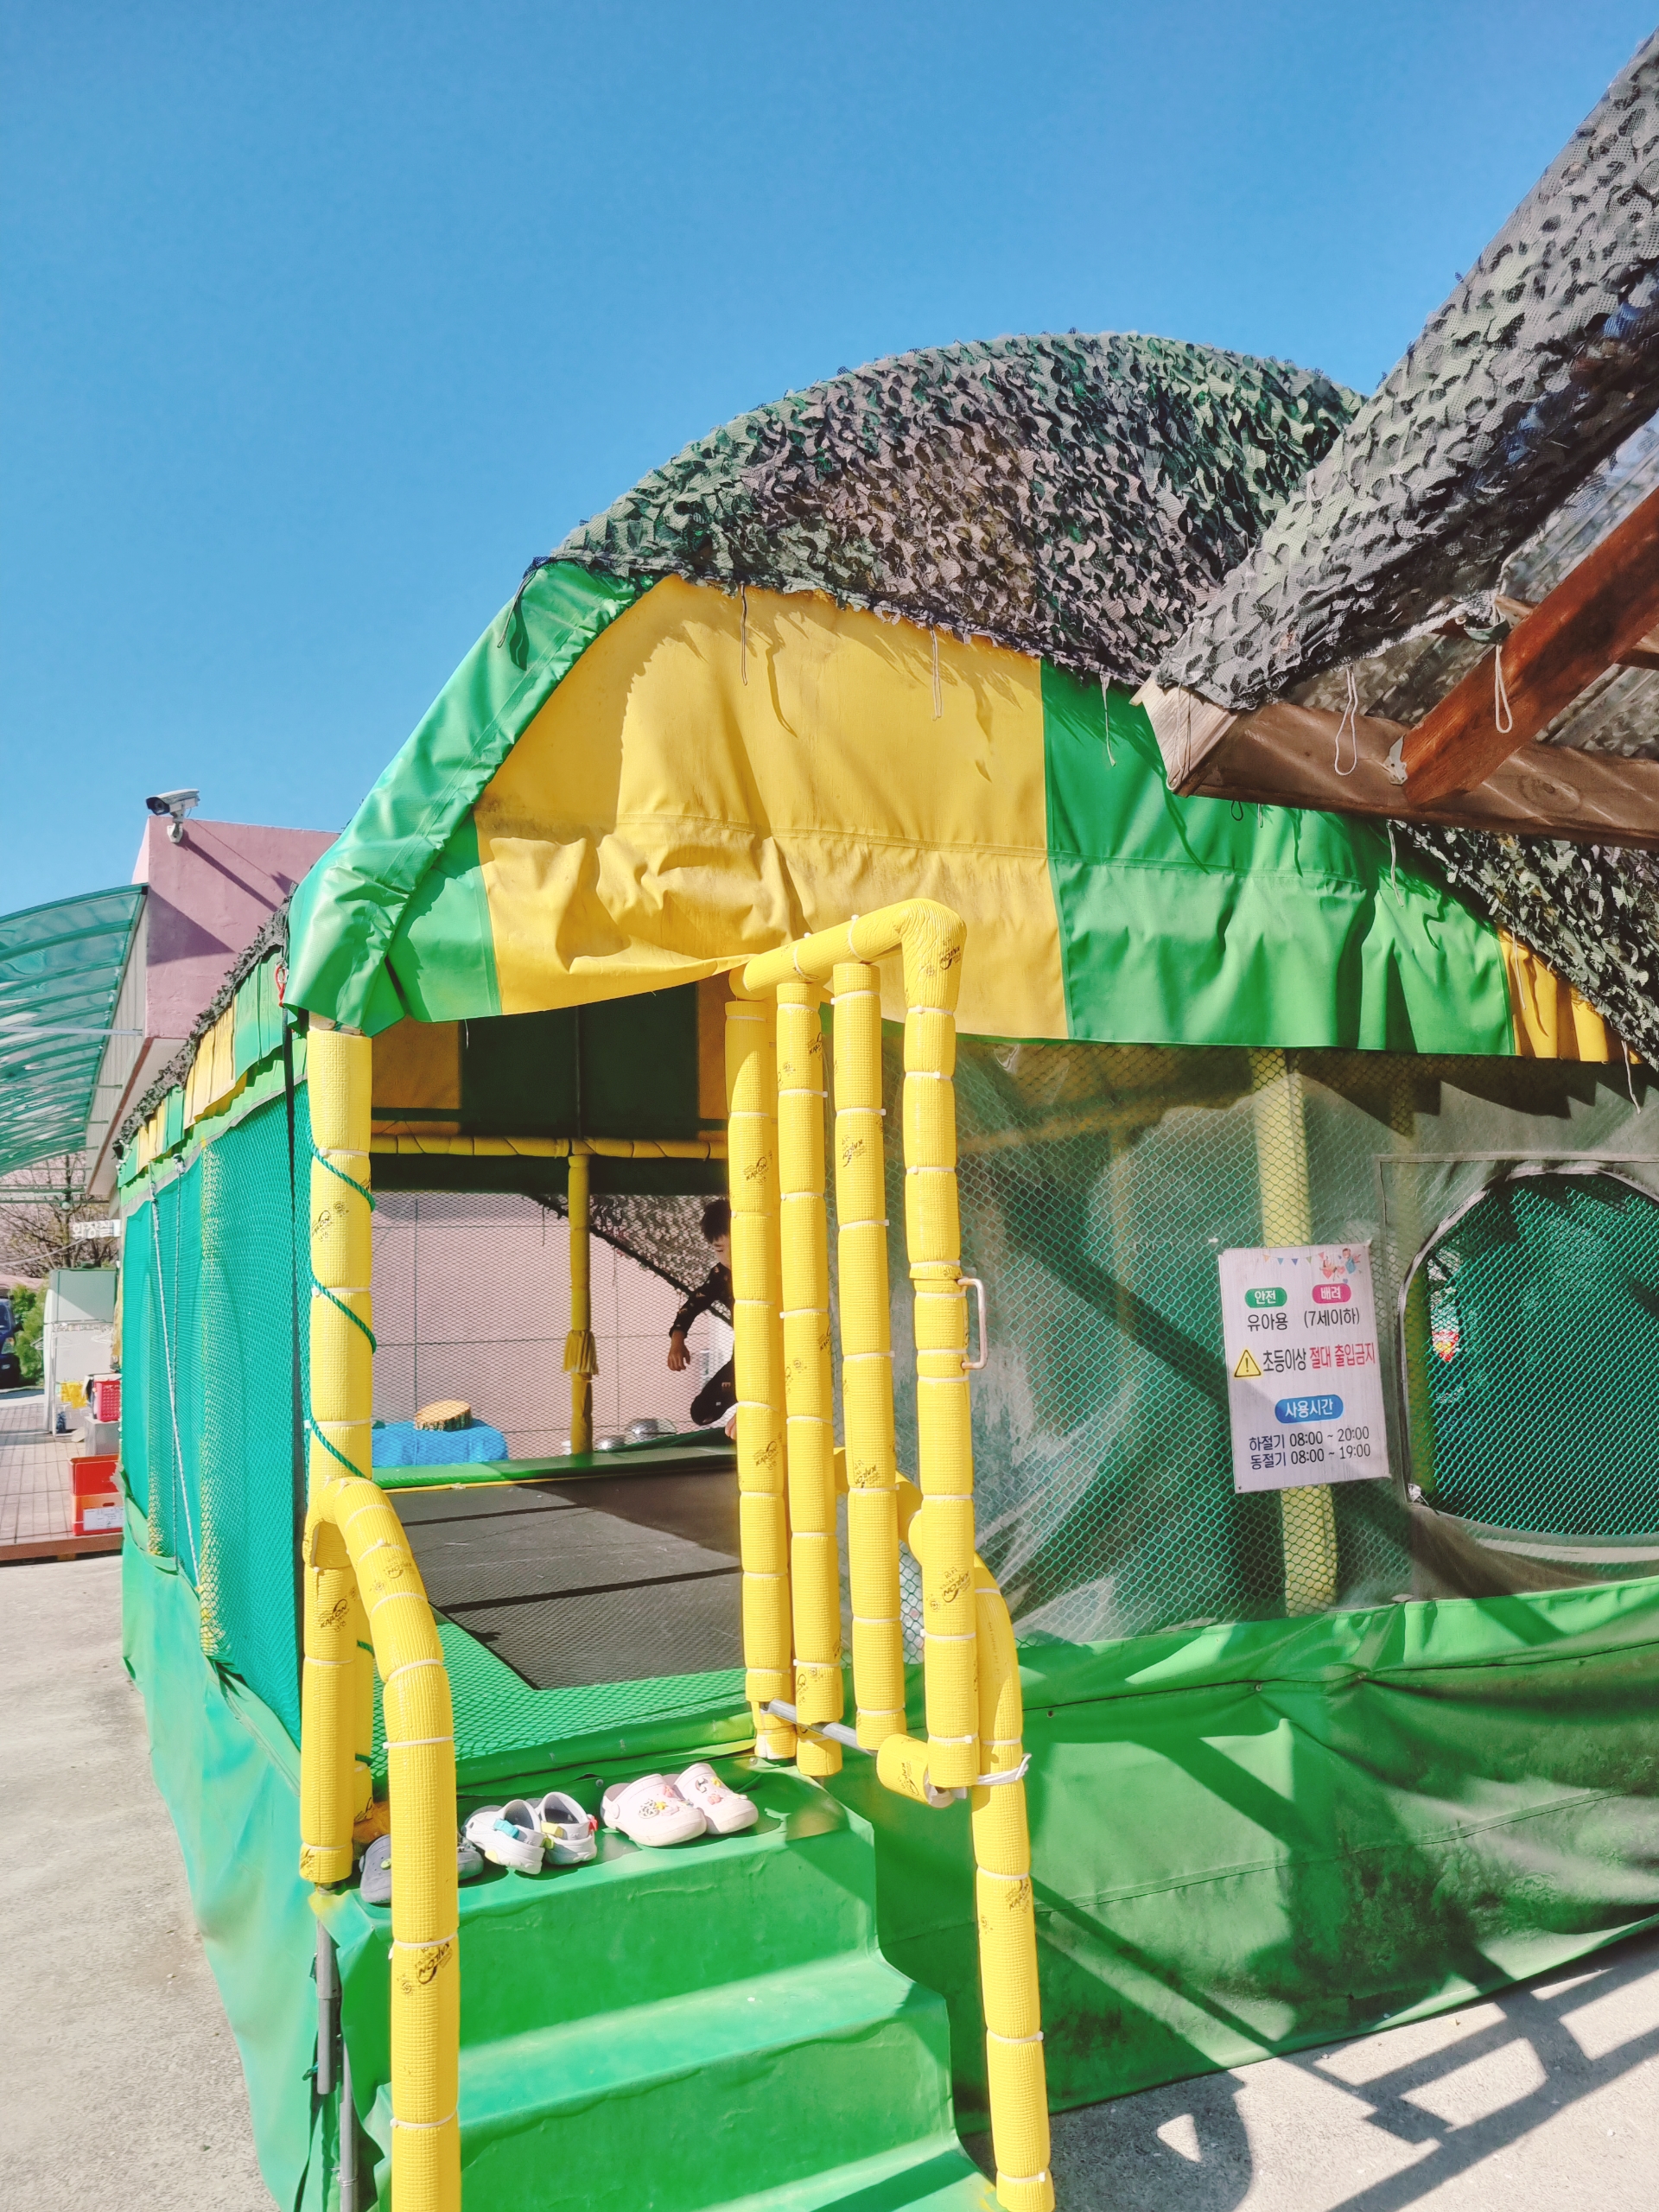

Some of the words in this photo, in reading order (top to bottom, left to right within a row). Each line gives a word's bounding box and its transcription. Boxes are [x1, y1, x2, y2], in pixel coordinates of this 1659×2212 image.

[1254, 1289, 1277, 1306] 안전
[1320, 1287, 1342, 1301] 배려
[1247, 1312, 1289, 1332] 유아용
[1304, 1307, 1360, 1330] (7세이하)
[1262, 1348, 1306, 1373] 초등이상
[1309, 1344, 1332, 1370] 절대
[1334, 1342, 1376, 1368] 출입금지
[1285, 1398, 1334, 1419] 사용시간
[1249, 1433, 1286, 1452] 하절기
[1289, 1430, 1324, 1448] 08:00
[1338, 1426, 1370, 1442] 20:00
[1249, 1452, 1287, 1471] 동절기
[1290, 1447, 1325, 1465] 08:00
[1338, 1443, 1370, 1460] 19:00
